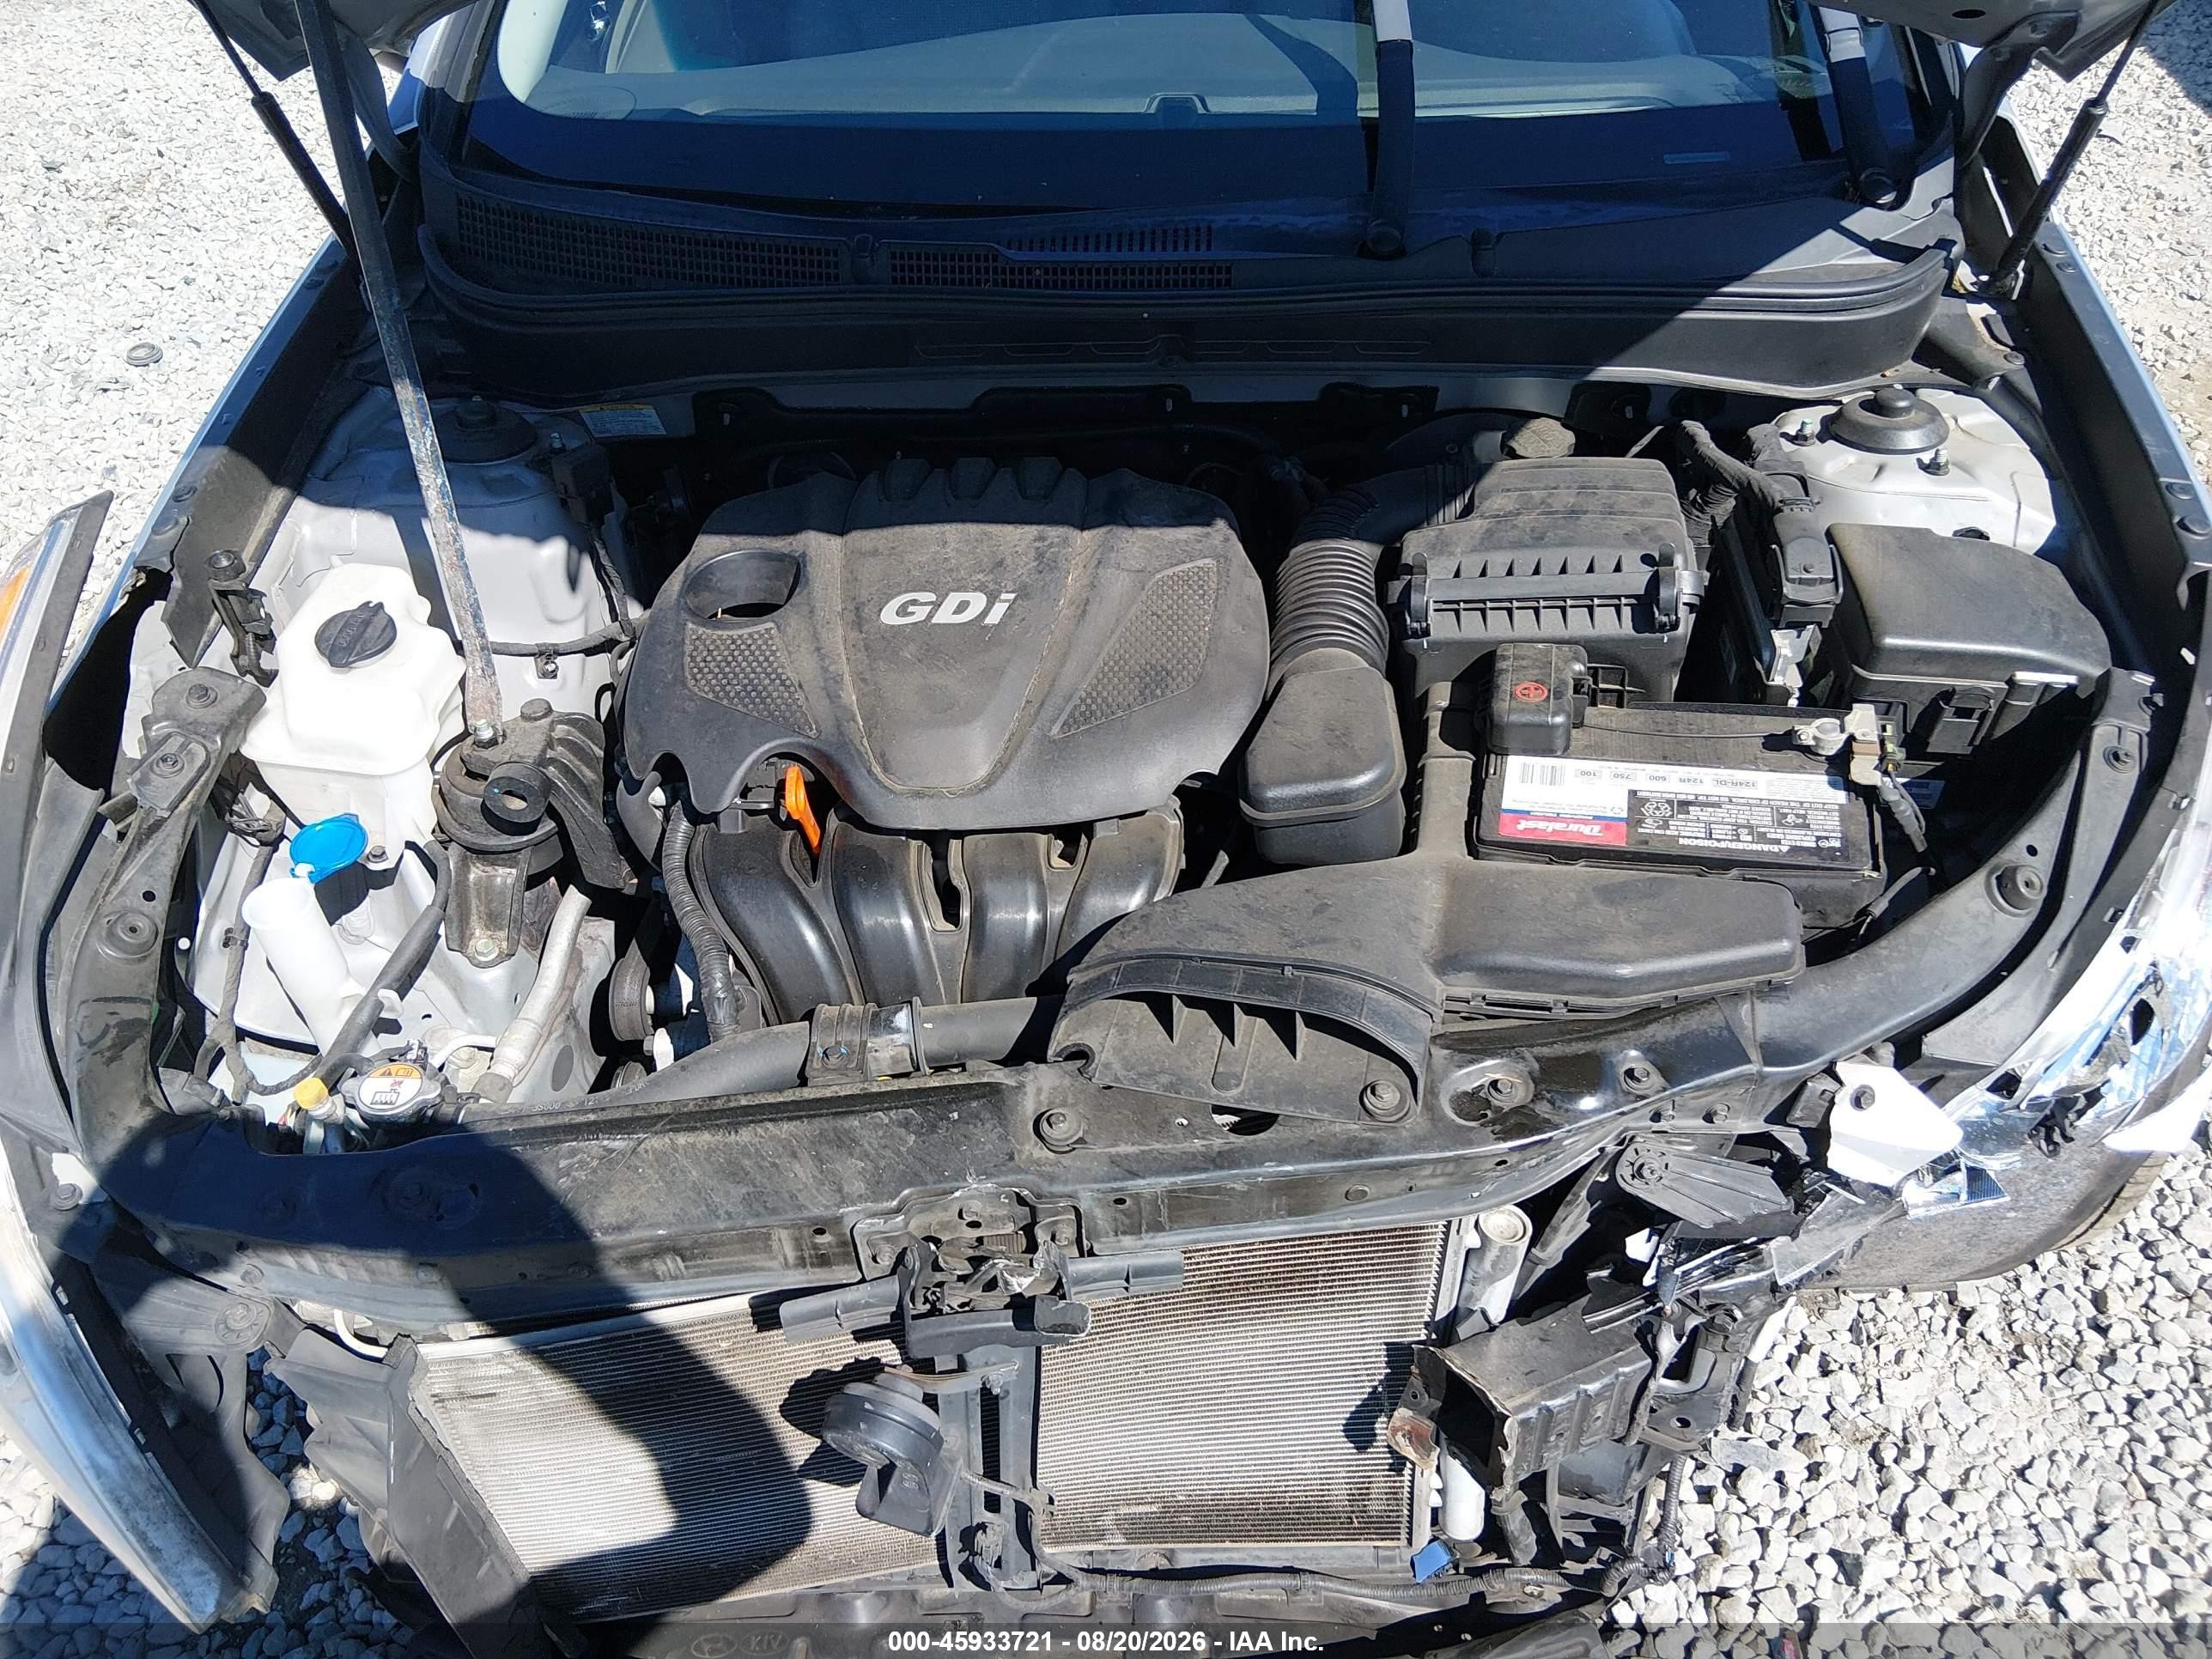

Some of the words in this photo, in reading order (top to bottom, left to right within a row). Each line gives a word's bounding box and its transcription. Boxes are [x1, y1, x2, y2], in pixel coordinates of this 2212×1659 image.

[879, 591, 1018, 626] GDi
[1516, 818, 1604, 836] Duralast
[1678, 837, 1779, 852] DANGER/POISON
